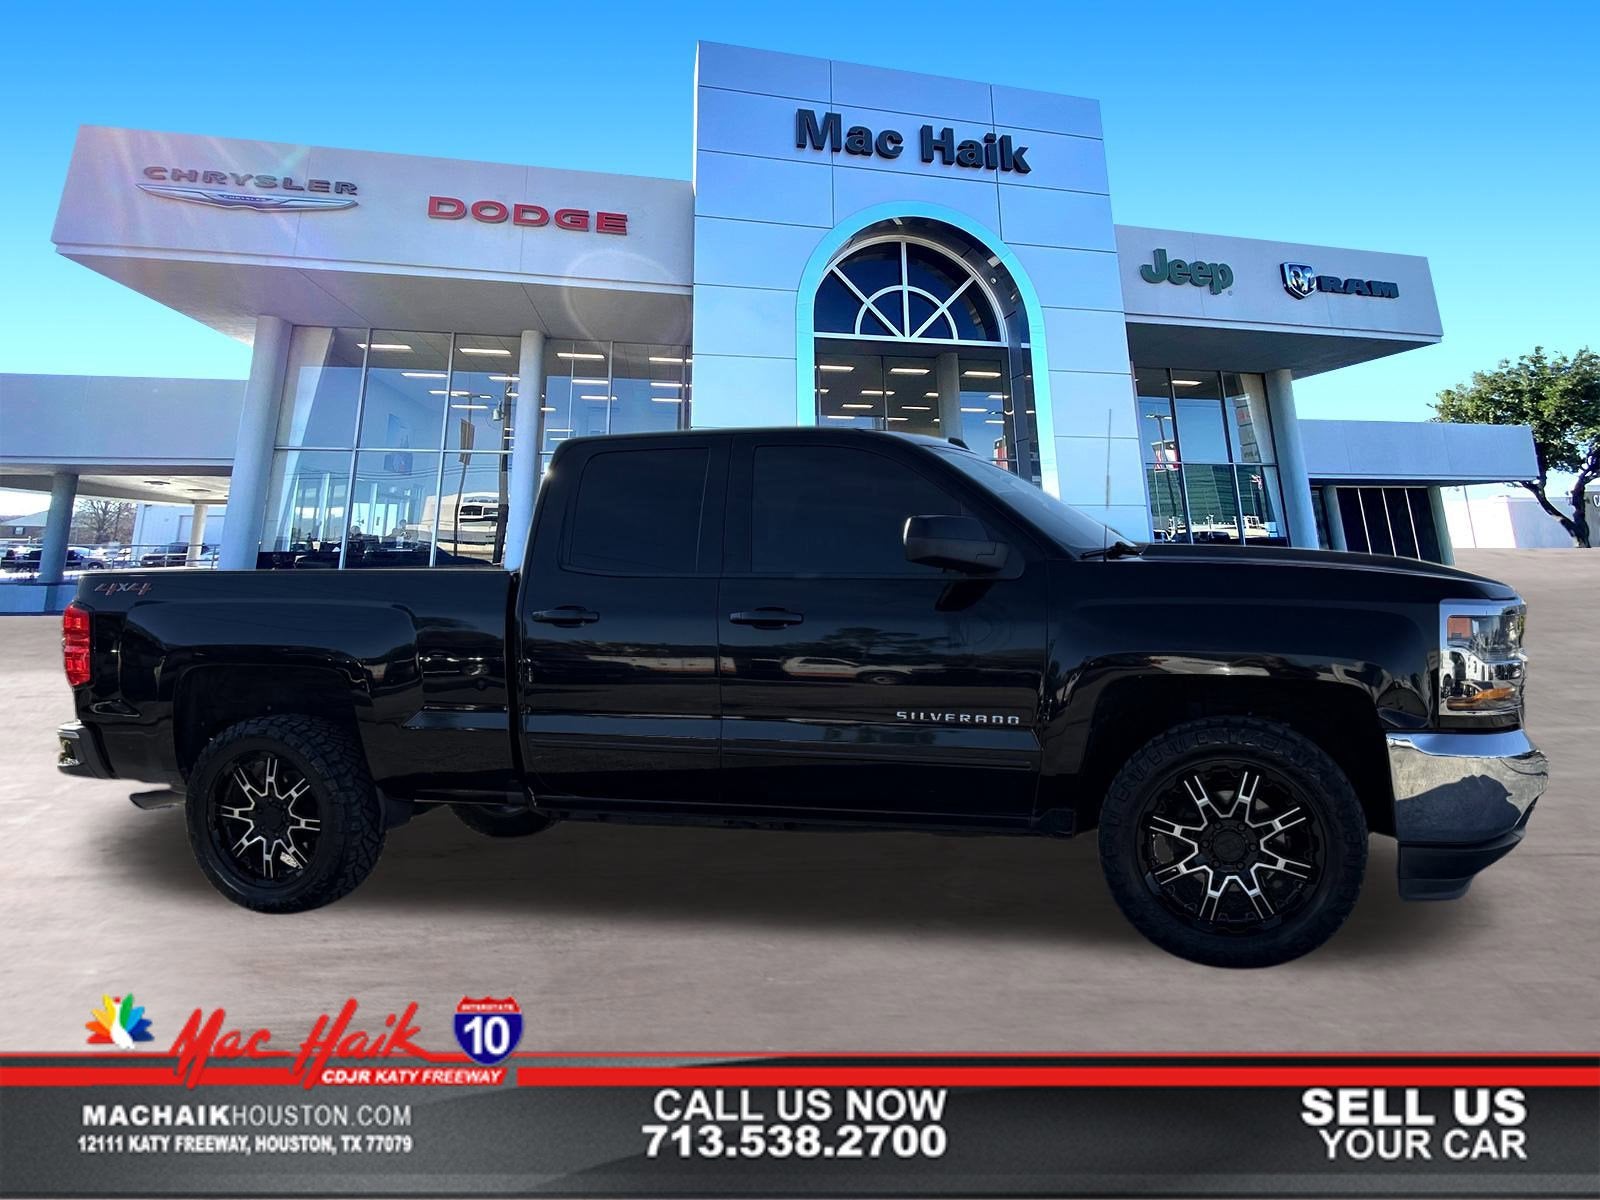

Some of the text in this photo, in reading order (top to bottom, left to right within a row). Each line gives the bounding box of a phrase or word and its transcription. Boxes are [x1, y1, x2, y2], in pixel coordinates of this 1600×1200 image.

[795, 108, 1031, 174] Mac Haik
[143, 165, 358, 196] CHRYSLER
[427, 196, 628, 236] DODGE
[1140, 248, 1234, 296] Jeep
[1316, 275, 1399, 299] RAM
[896, 711, 1020, 725] SILVERADO
